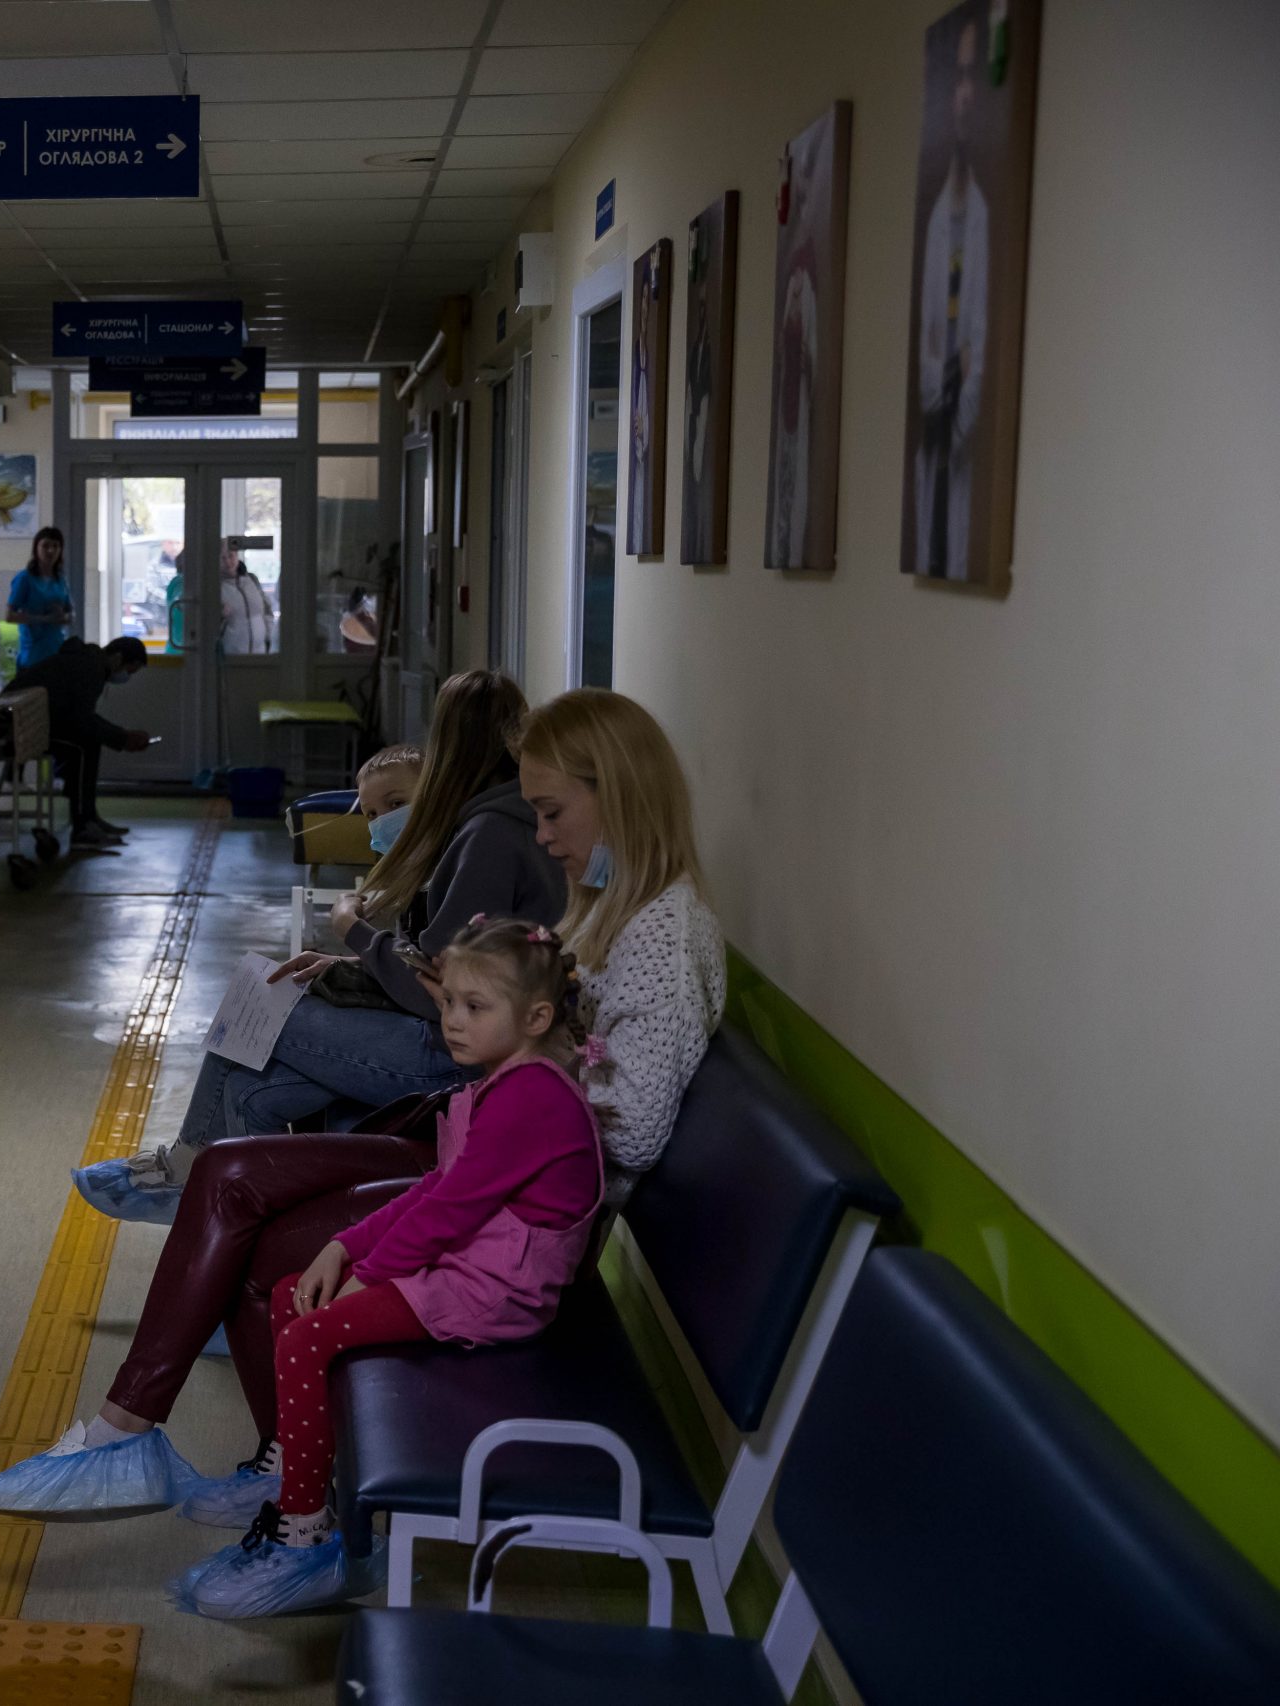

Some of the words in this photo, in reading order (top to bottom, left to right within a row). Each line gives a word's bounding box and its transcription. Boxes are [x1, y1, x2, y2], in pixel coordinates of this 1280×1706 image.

[46, 128, 136, 143] ХІРУРГІЧНА
[39, 151, 129, 167] ОГЛЯДОВА
[133, 151, 144, 165] 2
[89, 318, 139, 328] ХІРУРГІЧНА
